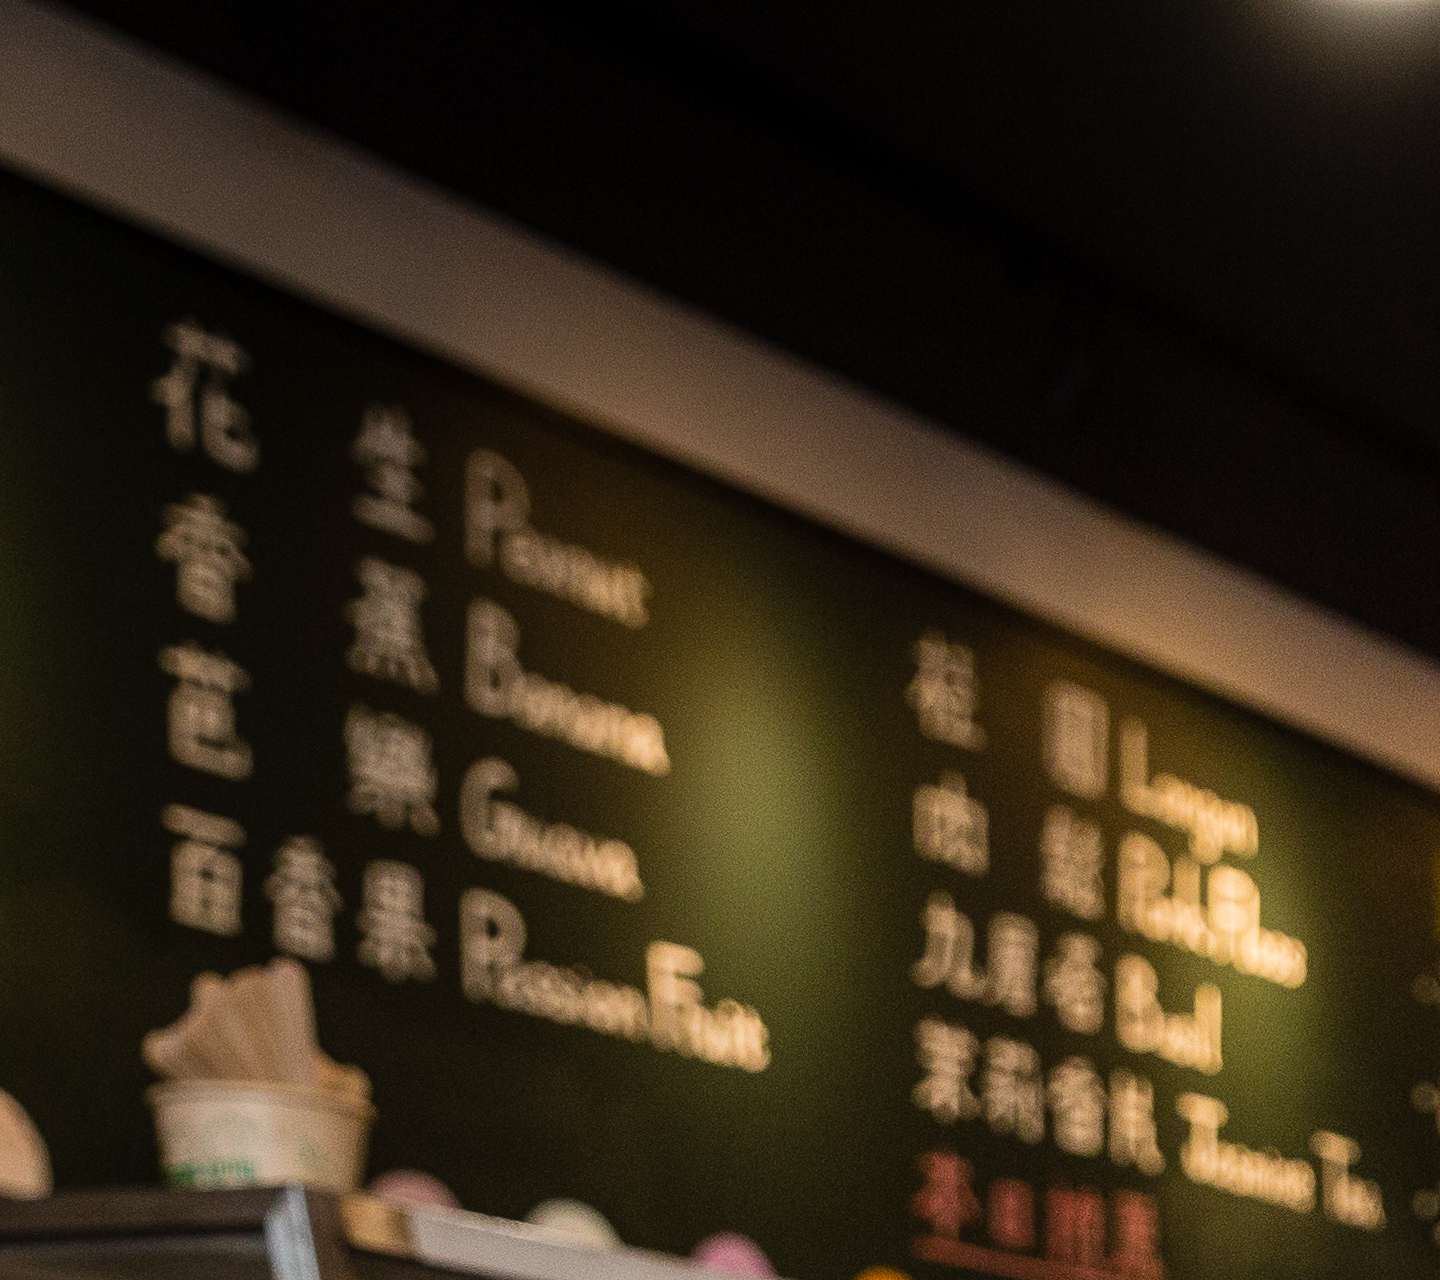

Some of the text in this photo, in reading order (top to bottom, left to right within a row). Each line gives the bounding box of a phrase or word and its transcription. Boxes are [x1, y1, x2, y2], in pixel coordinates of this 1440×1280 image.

[462, 449, 653, 629] Peanut
[464, 599, 670, 776] Banana
[459, 757, 644, 902] Guava
[459, 887, 772, 1072] Passion Fruit
